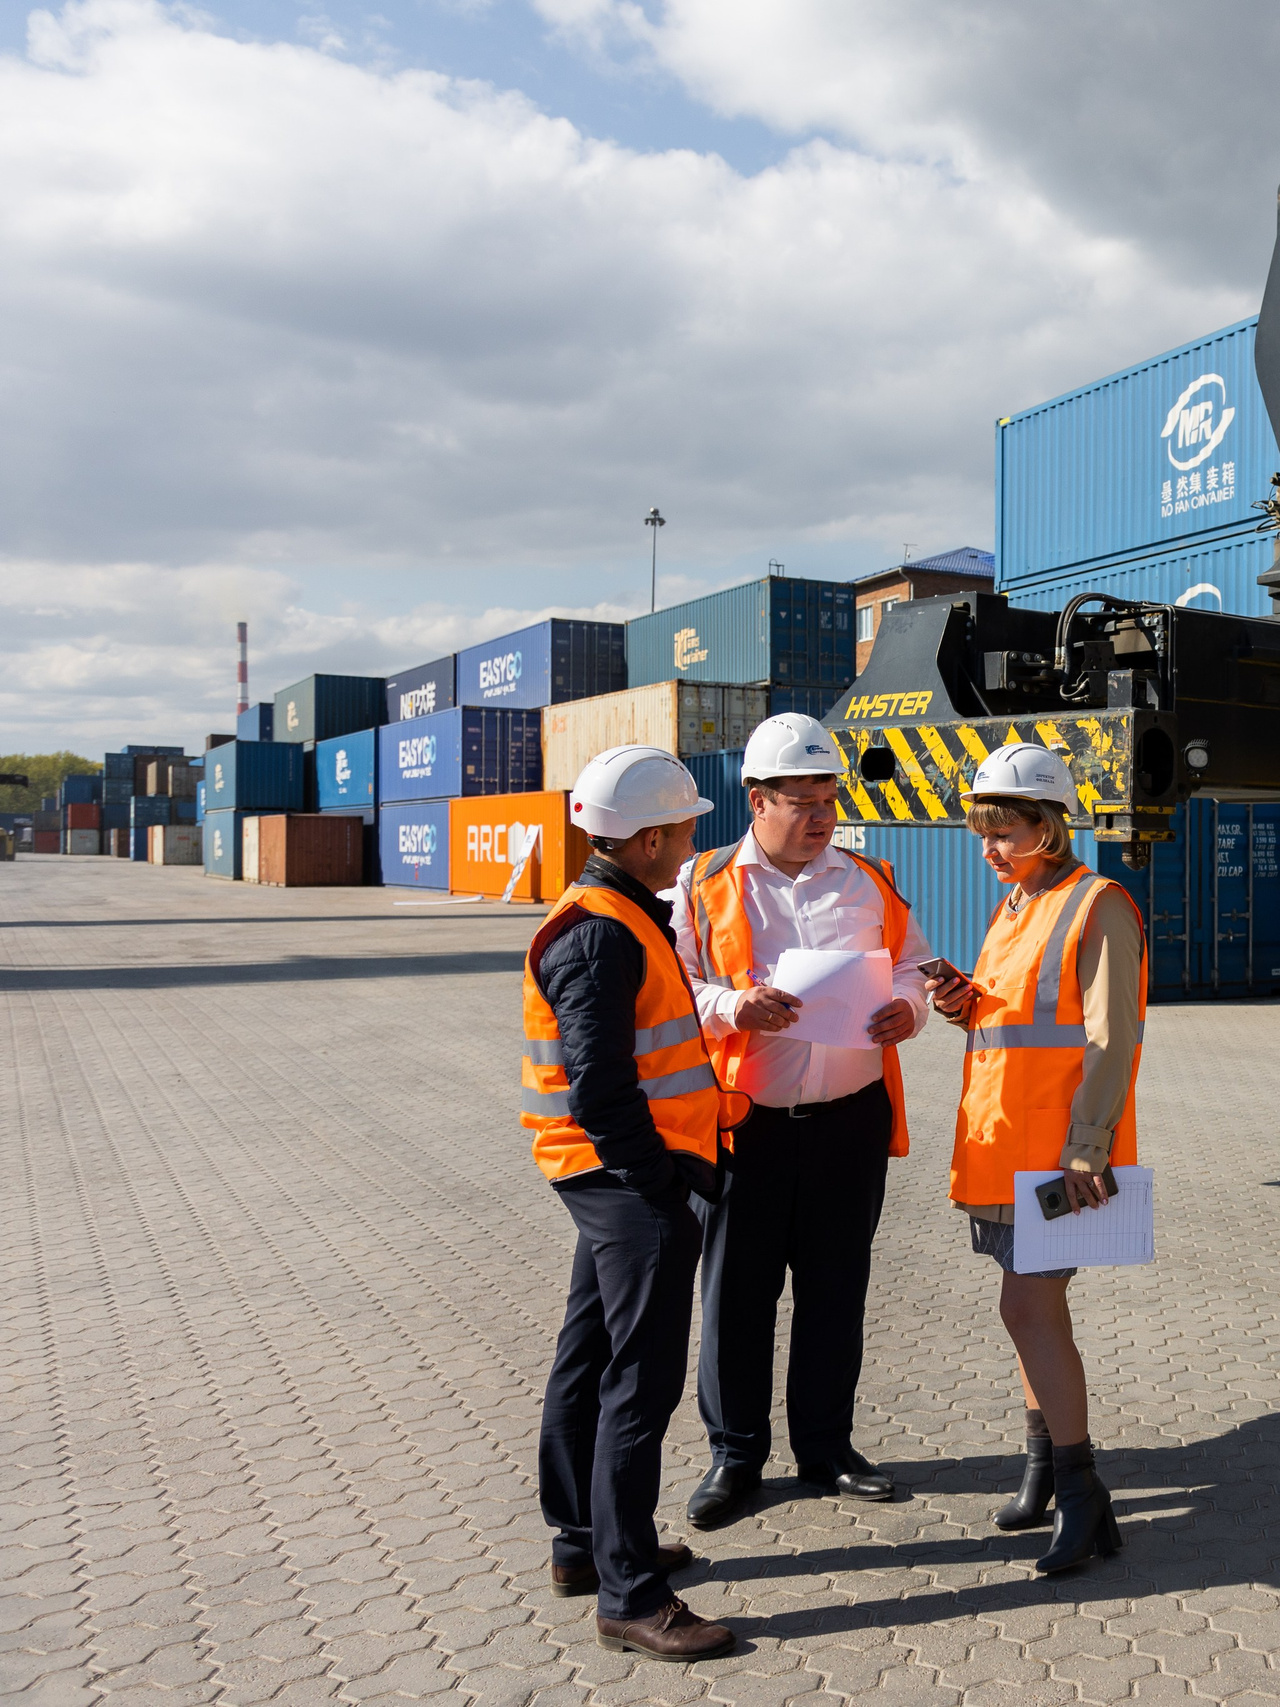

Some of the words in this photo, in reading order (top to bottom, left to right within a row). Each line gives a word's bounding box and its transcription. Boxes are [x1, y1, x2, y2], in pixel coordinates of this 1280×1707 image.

[479, 650, 522, 689] EASYGO
[844, 690, 933, 720] HYSTER
[399, 735, 436, 768] EASYGO
[399, 824, 437, 853] EASYGO
[830, 825, 866, 849] ans
[1218, 838, 1236, 849] TARE
